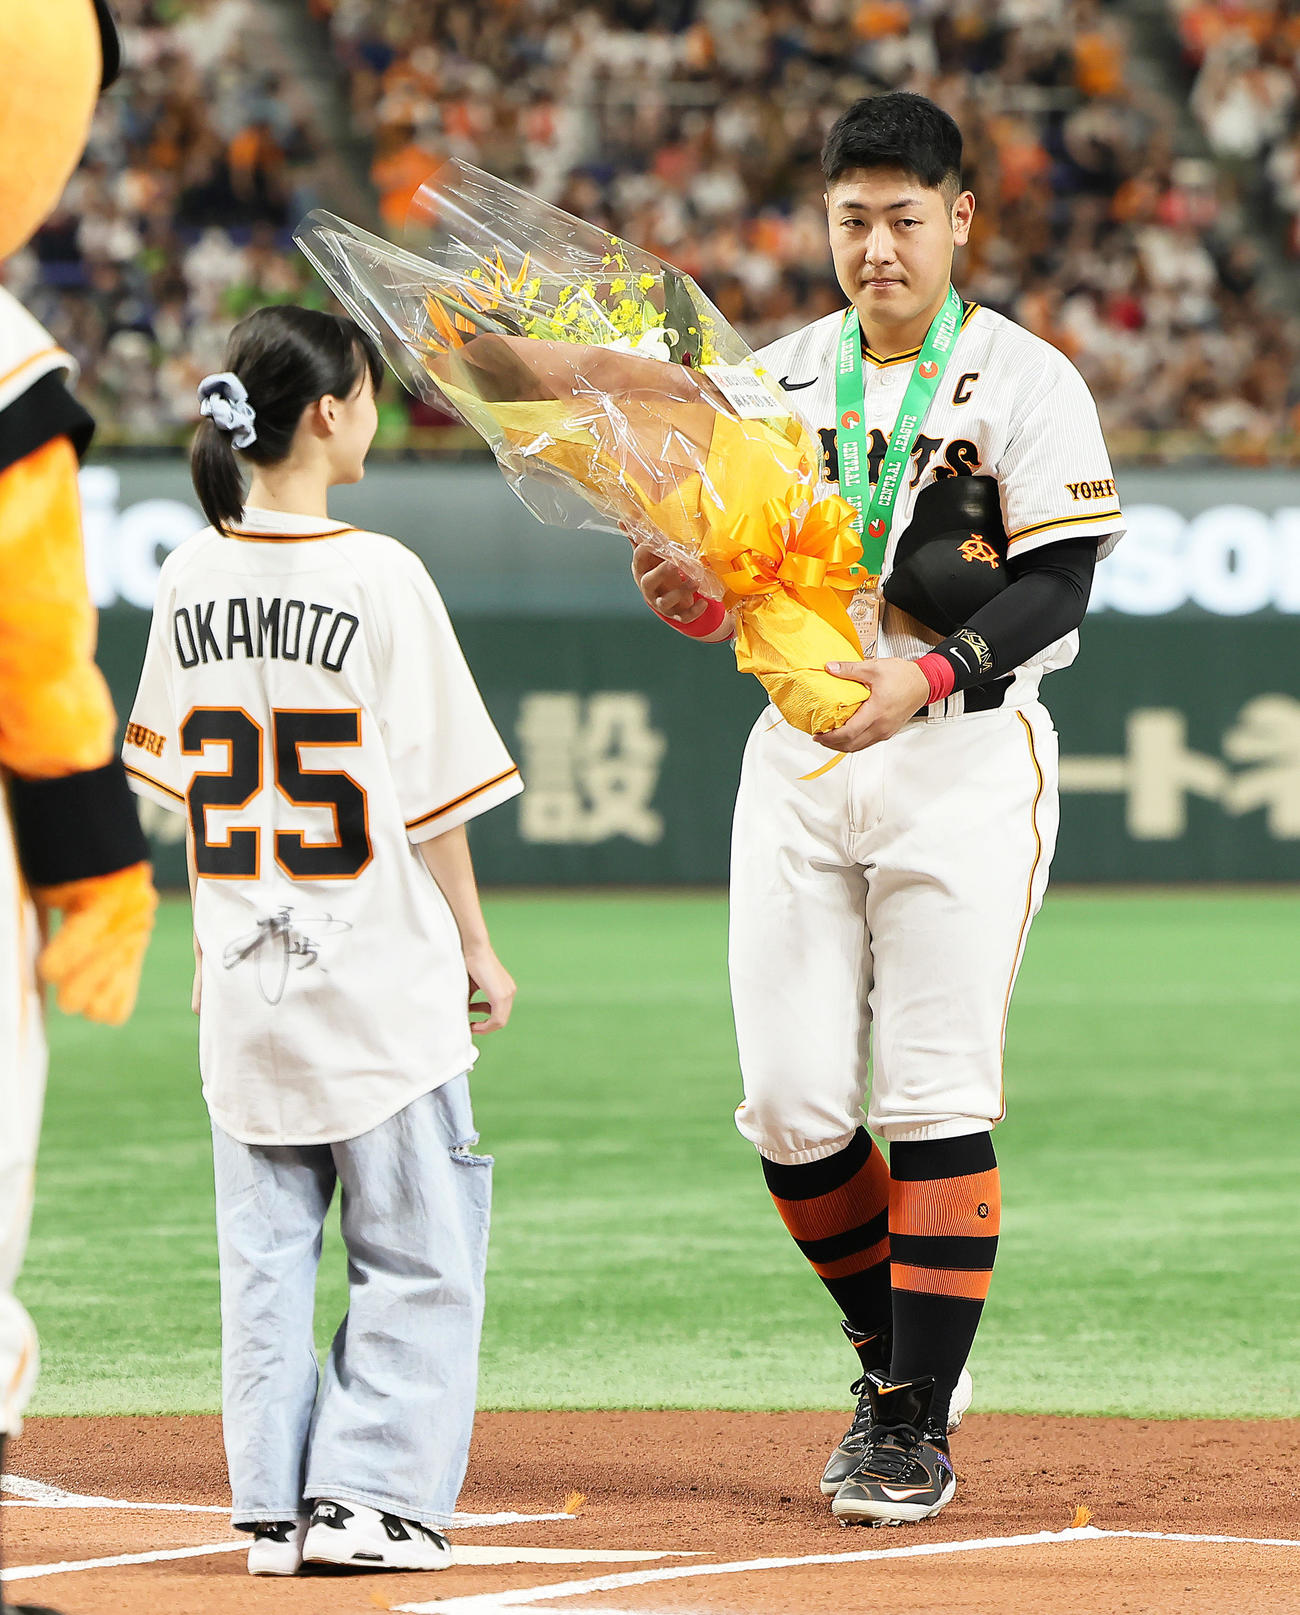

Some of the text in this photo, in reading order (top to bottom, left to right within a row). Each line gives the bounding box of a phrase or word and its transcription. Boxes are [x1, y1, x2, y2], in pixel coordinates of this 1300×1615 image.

[931, 311, 957, 353] CENTRAL
[952, 372, 980, 407] C
[842, 441, 861, 487] CENTRAL
[877, 414, 918, 506] CENTRAL LEAGUE
[1064, 479, 1116, 501] YOMI
[173, 597, 360, 673] OKAMOTO
[178, 705, 374, 881] 25
